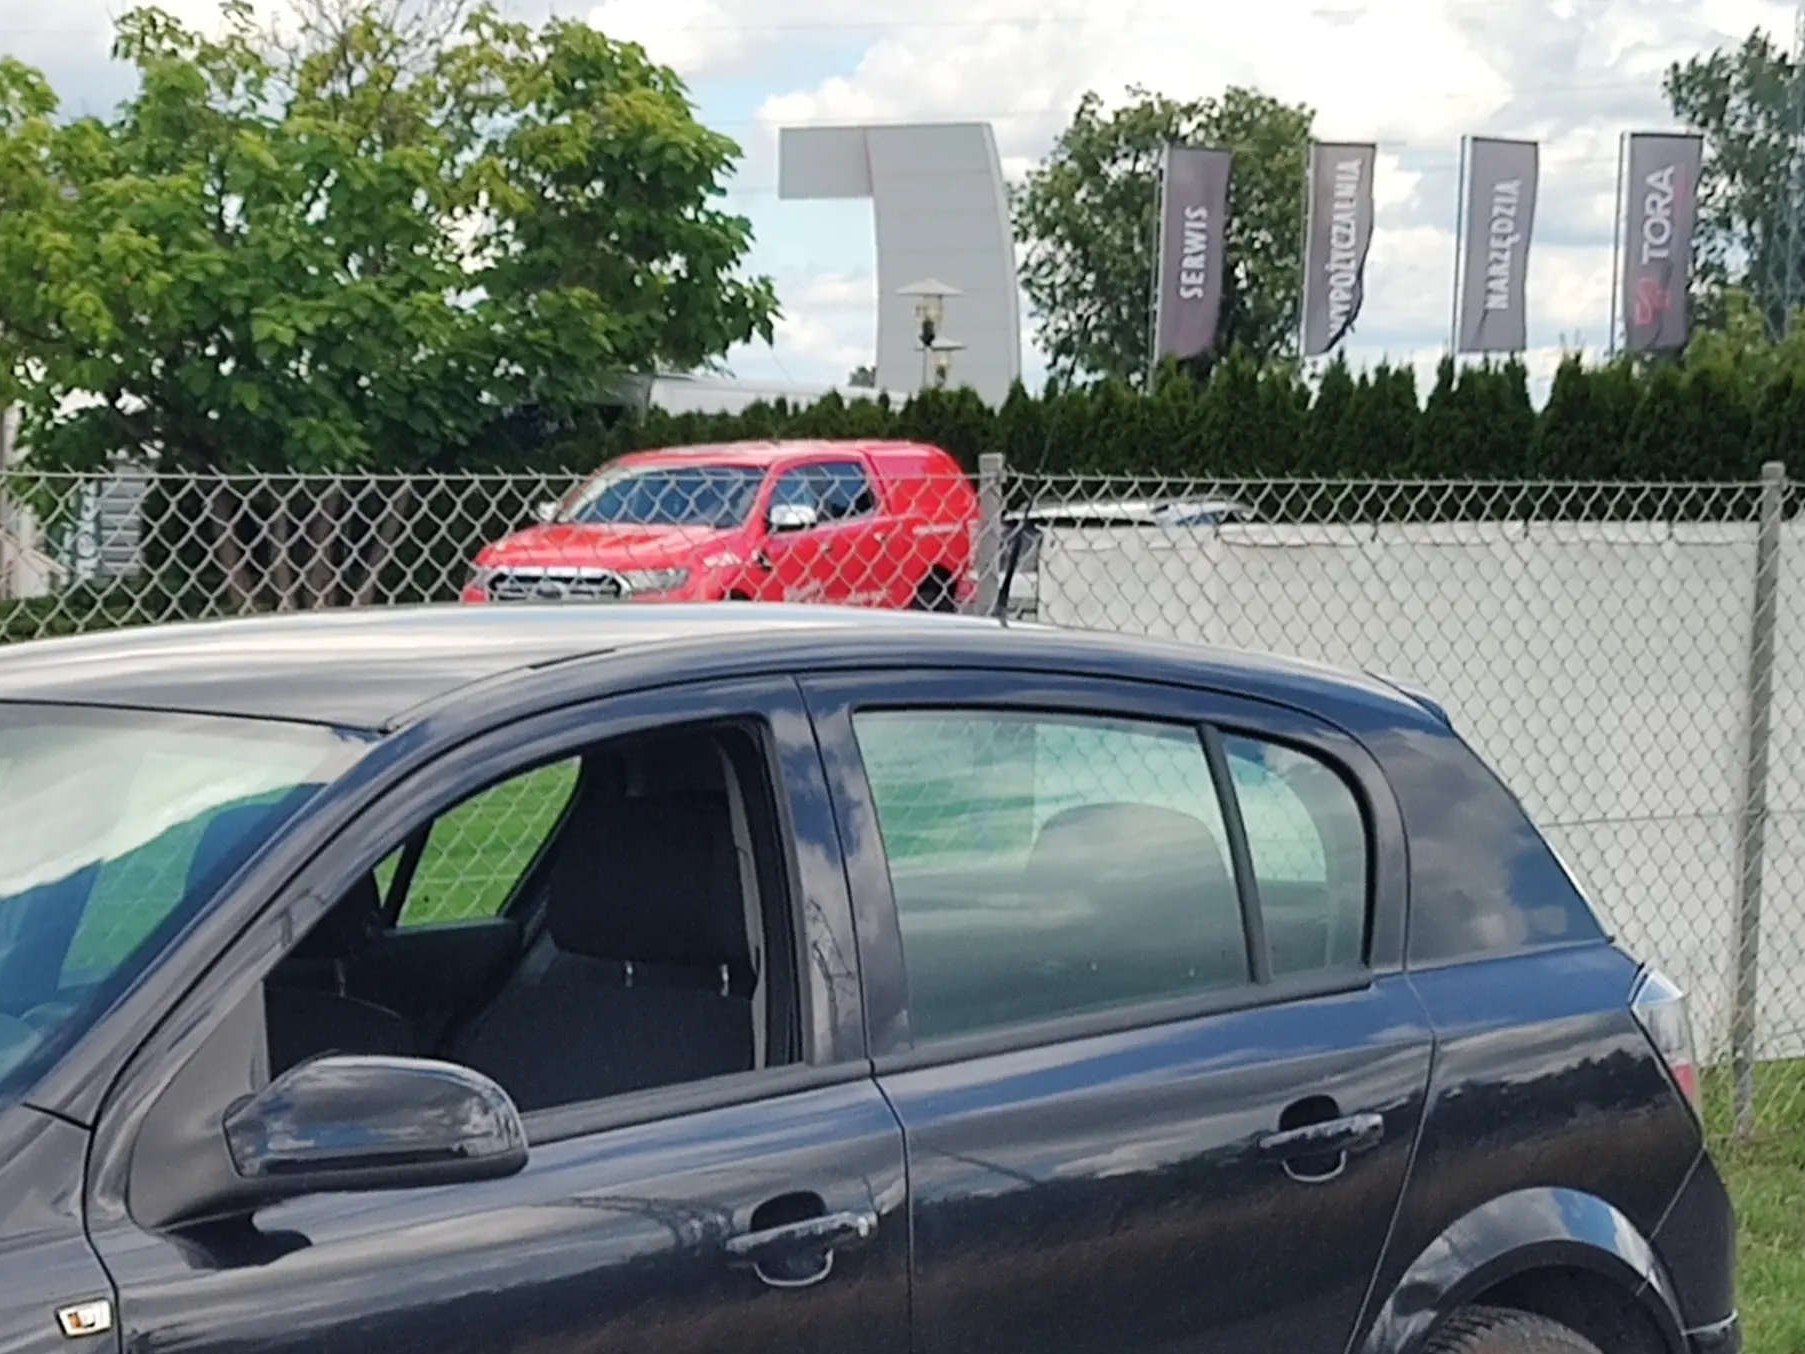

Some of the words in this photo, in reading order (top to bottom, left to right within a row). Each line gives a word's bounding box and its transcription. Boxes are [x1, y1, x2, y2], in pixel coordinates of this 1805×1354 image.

[1179, 205, 1208, 299] SERWIS
[1485, 177, 1522, 310] NARZĘDZIA
[1642, 164, 1676, 266] TORA
